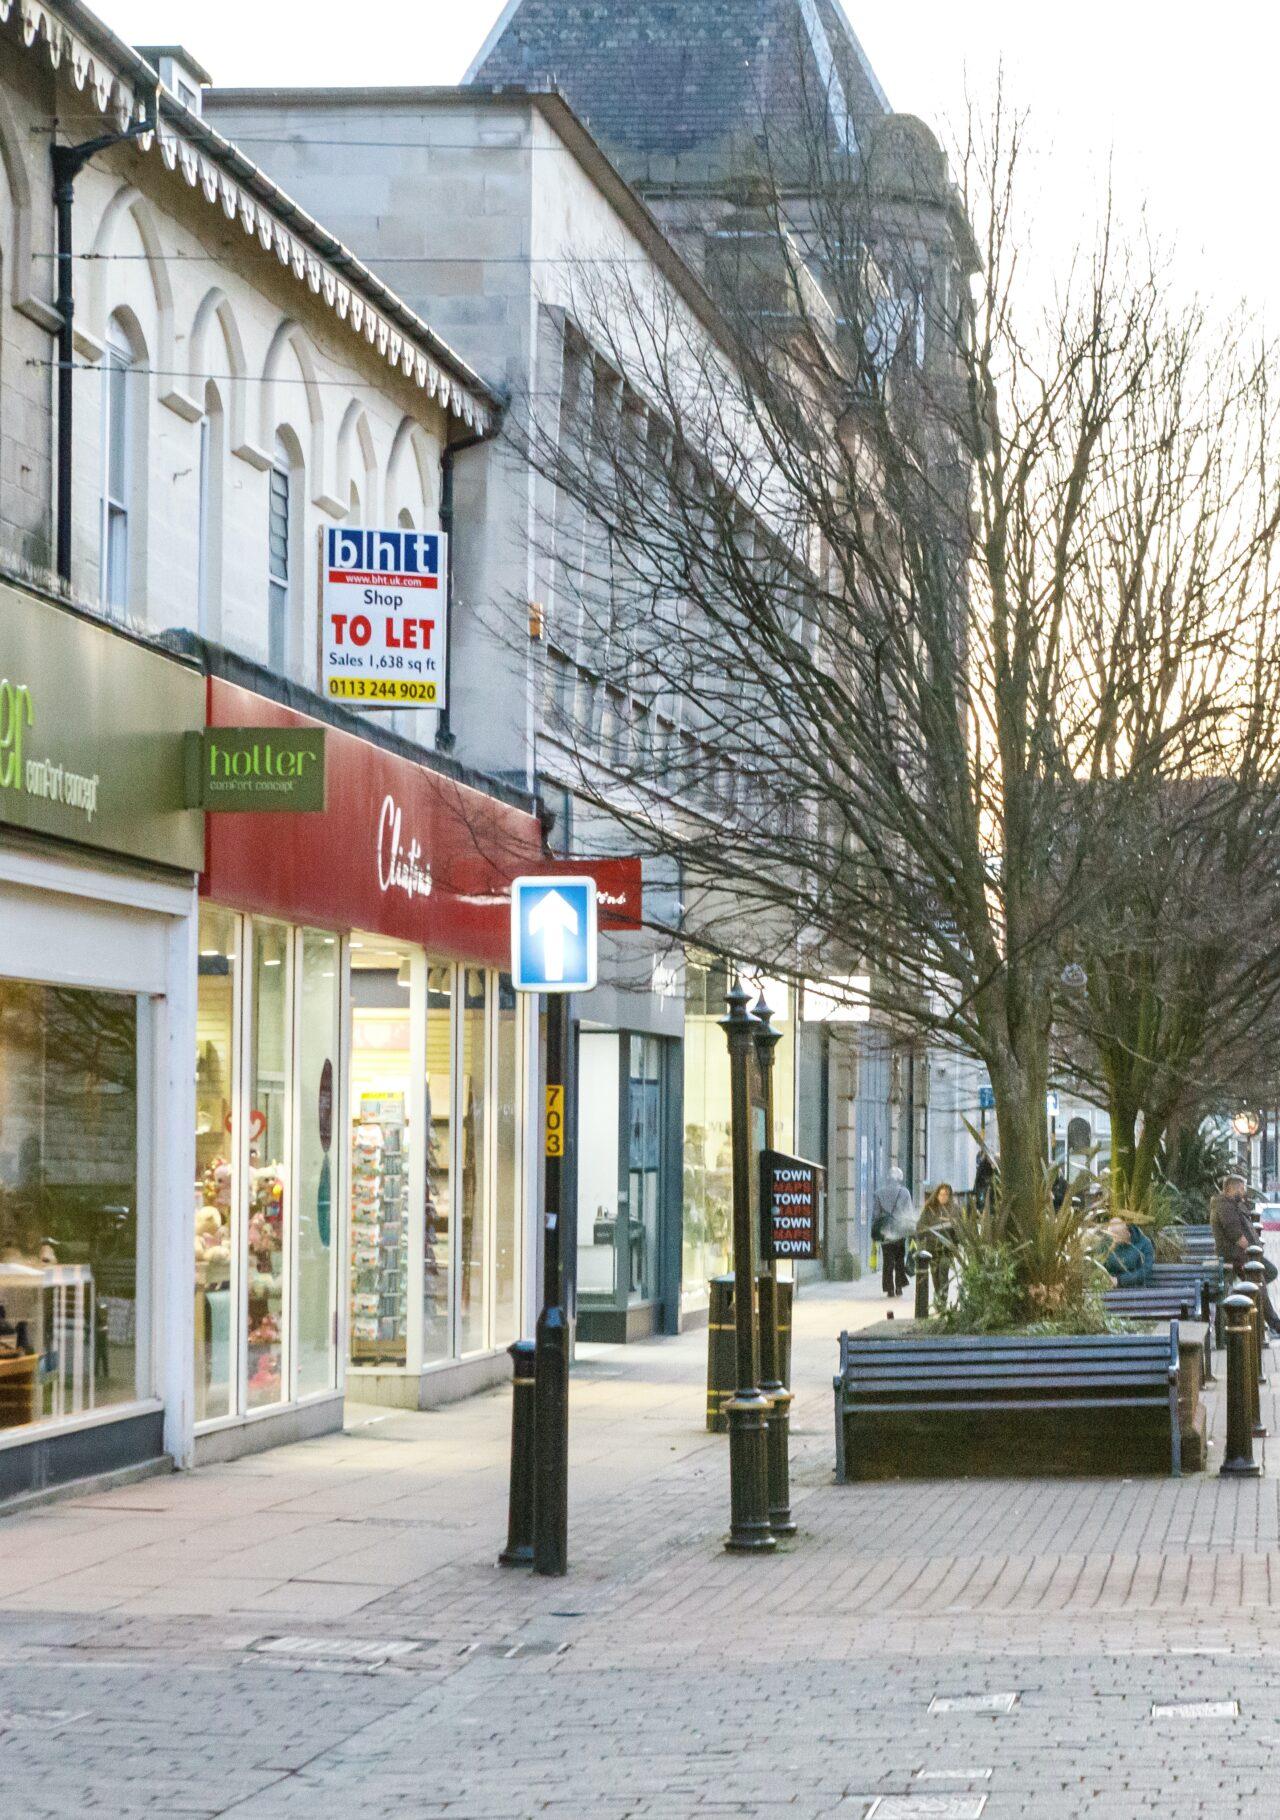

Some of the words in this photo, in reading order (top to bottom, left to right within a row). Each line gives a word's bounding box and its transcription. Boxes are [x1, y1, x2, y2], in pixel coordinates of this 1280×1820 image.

[334, 529, 430, 574] bht
[345, 574, 422, 587] www.bht.uk.com
[363, 589, 404, 610] Shop
[331, 613, 372, 647] TO
[385, 617, 435, 649] LET
[329, 652, 364, 667] Sales
[370, 654, 404, 671] 1,638
[408, 658, 422, 673] sq
[426, 657, 437, 671] ft
[329, 679, 366, 696] 0113
[370, 681, 397, 697] 244
[400, 682, 436, 699] 9020
[546, 1087, 561, 1153] 703
[773, 1169, 811, 1181] TOWN
[773, 1193, 812, 1205] TOWN
[780, 1206, 812, 1216] APS
[773, 1217, 812, 1229] TOWN
[773, 1241, 811, 1252] TOWN
